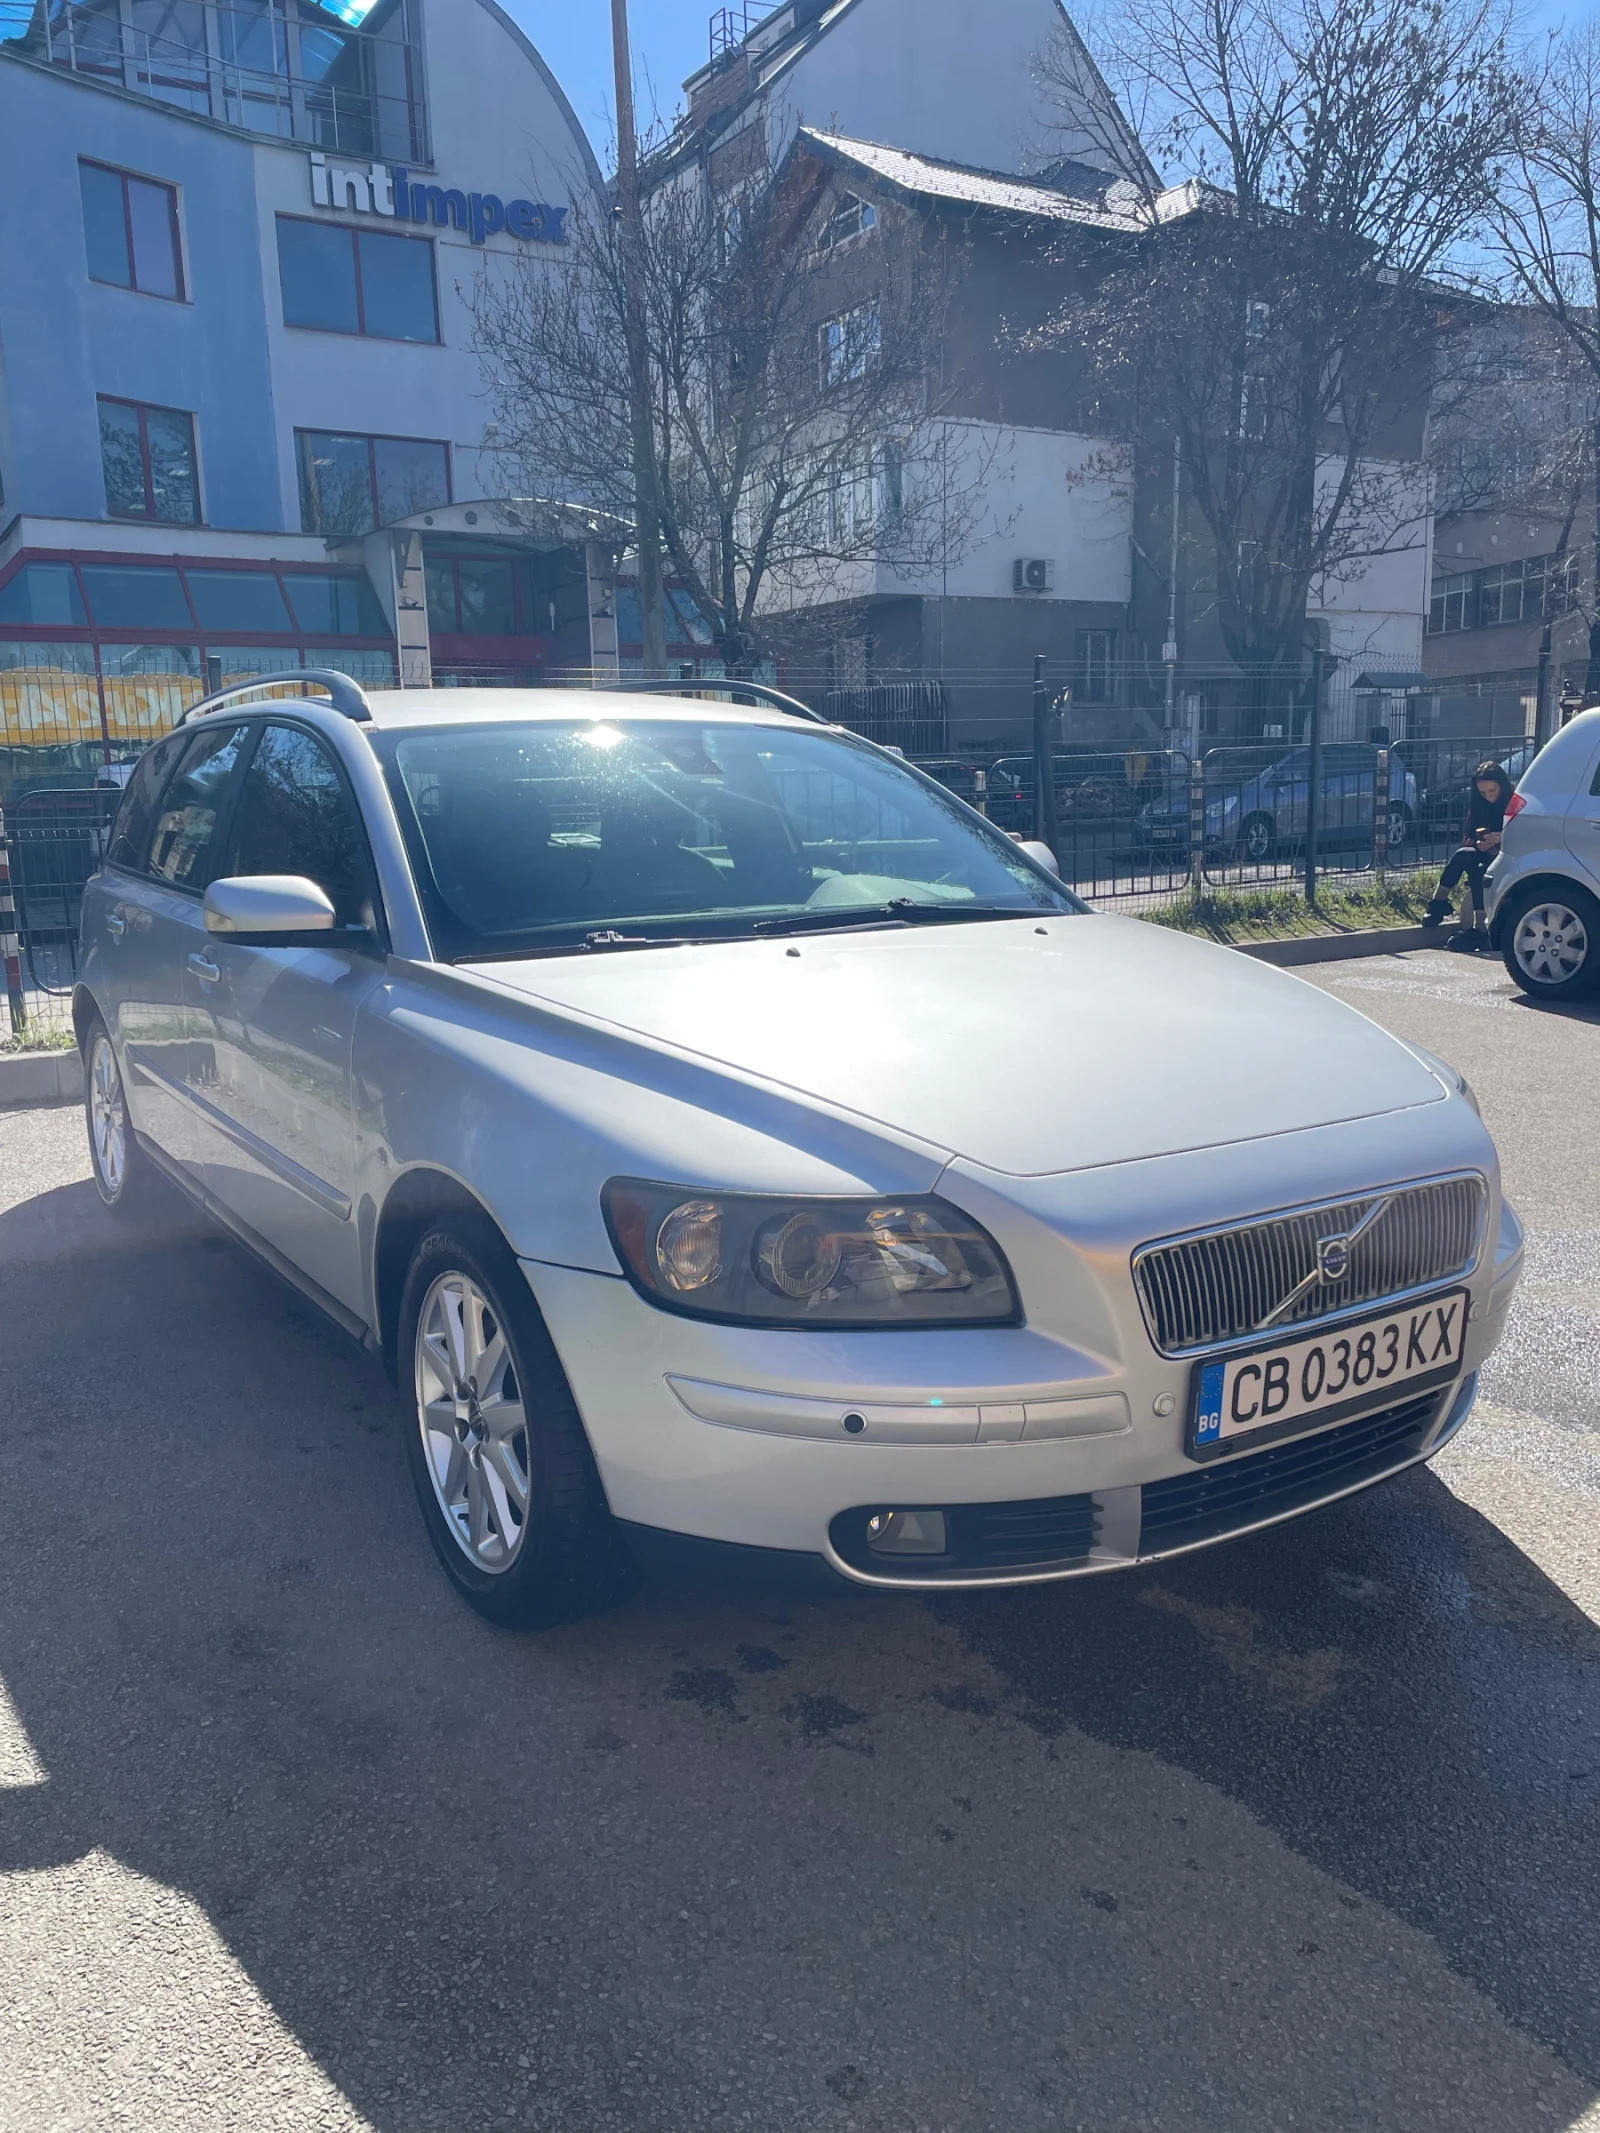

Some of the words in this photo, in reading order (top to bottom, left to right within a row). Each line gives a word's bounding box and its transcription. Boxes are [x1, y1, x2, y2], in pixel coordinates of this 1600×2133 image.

[310, 152, 569, 246] intimpex
[1230, 1357, 1291, 1424] CB
[1301, 1323, 1401, 1403] 0383
[1405, 1303, 1459, 1371] KX
[1198, 1411, 1219, 1433] BG
